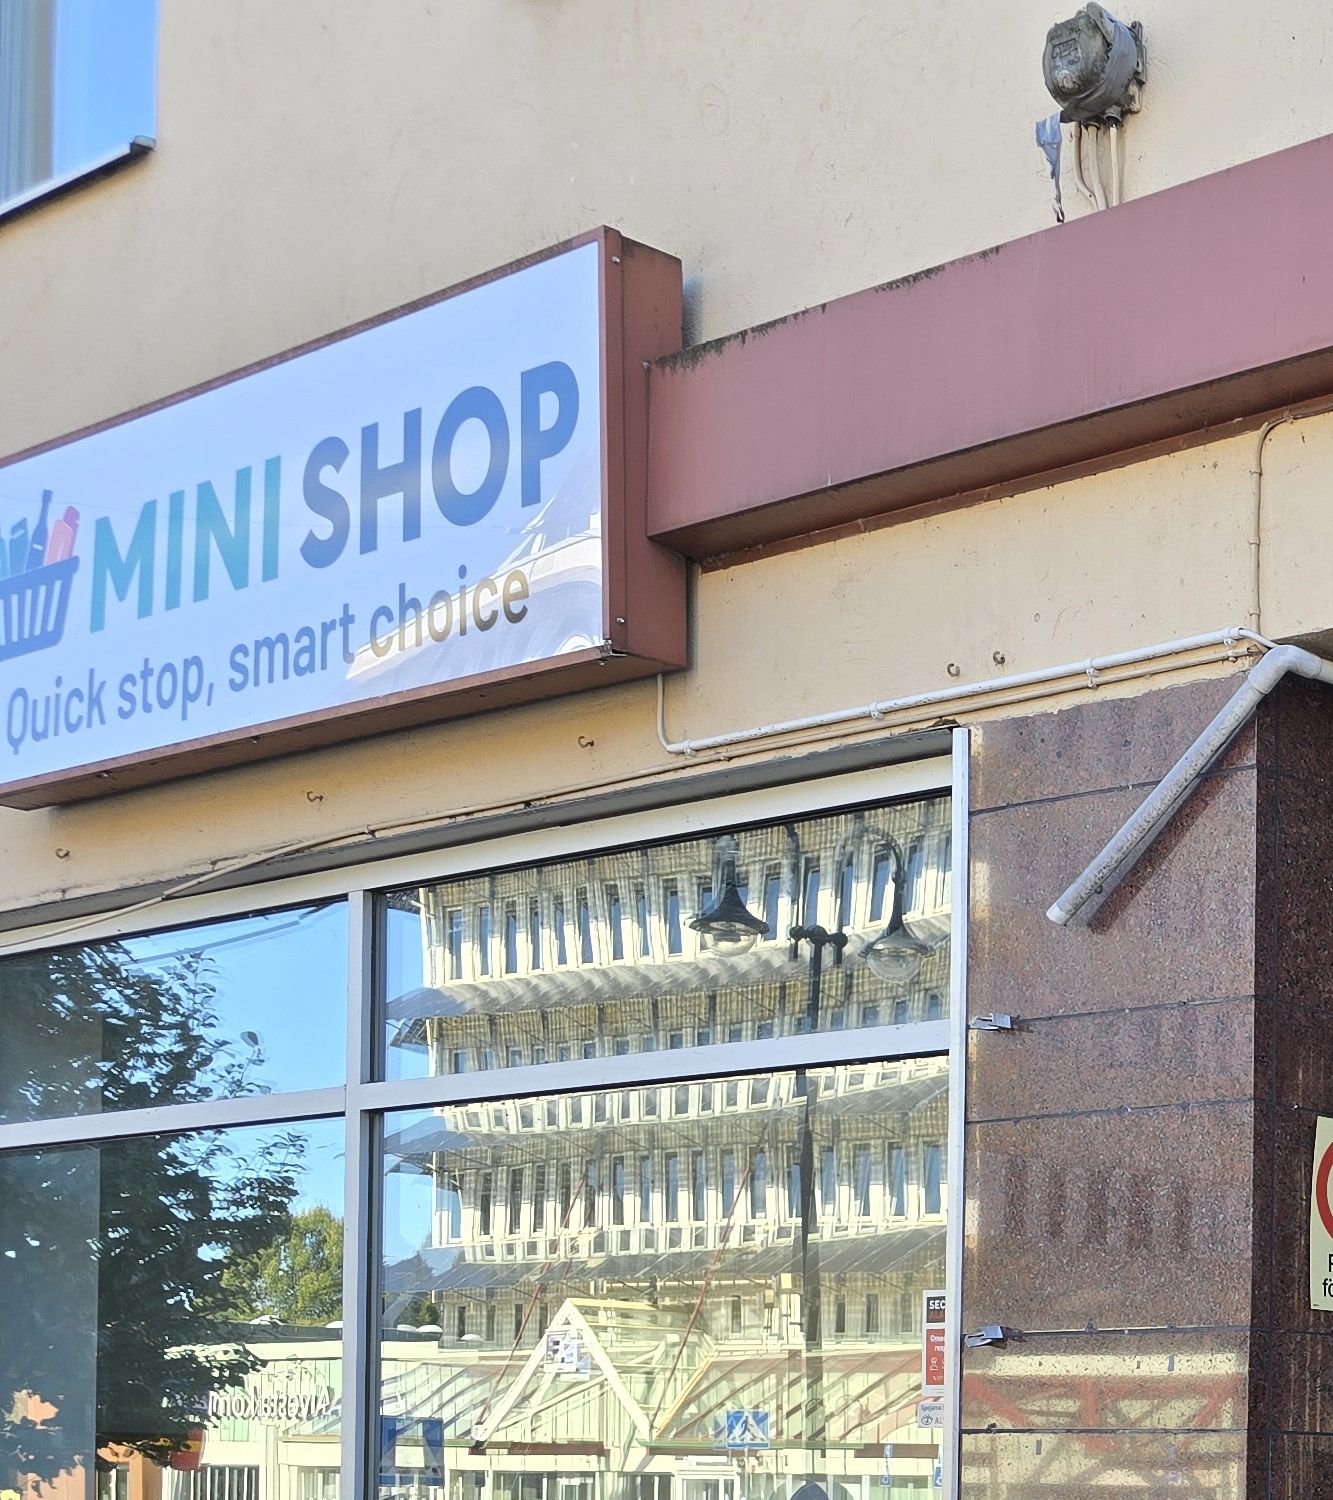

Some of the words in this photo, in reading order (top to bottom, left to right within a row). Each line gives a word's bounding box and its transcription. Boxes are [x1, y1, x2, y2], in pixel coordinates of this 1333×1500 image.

[90, 454, 282, 633] MINI
[300, 359, 580, 570] SHOP
[5, 669, 106, 755] Quick
[117, 652, 215, 722] stop,
[228, 603, 356, 692] smart
[369, 564, 529, 659] choice
[929, 1300, 946, 1310] SEC
